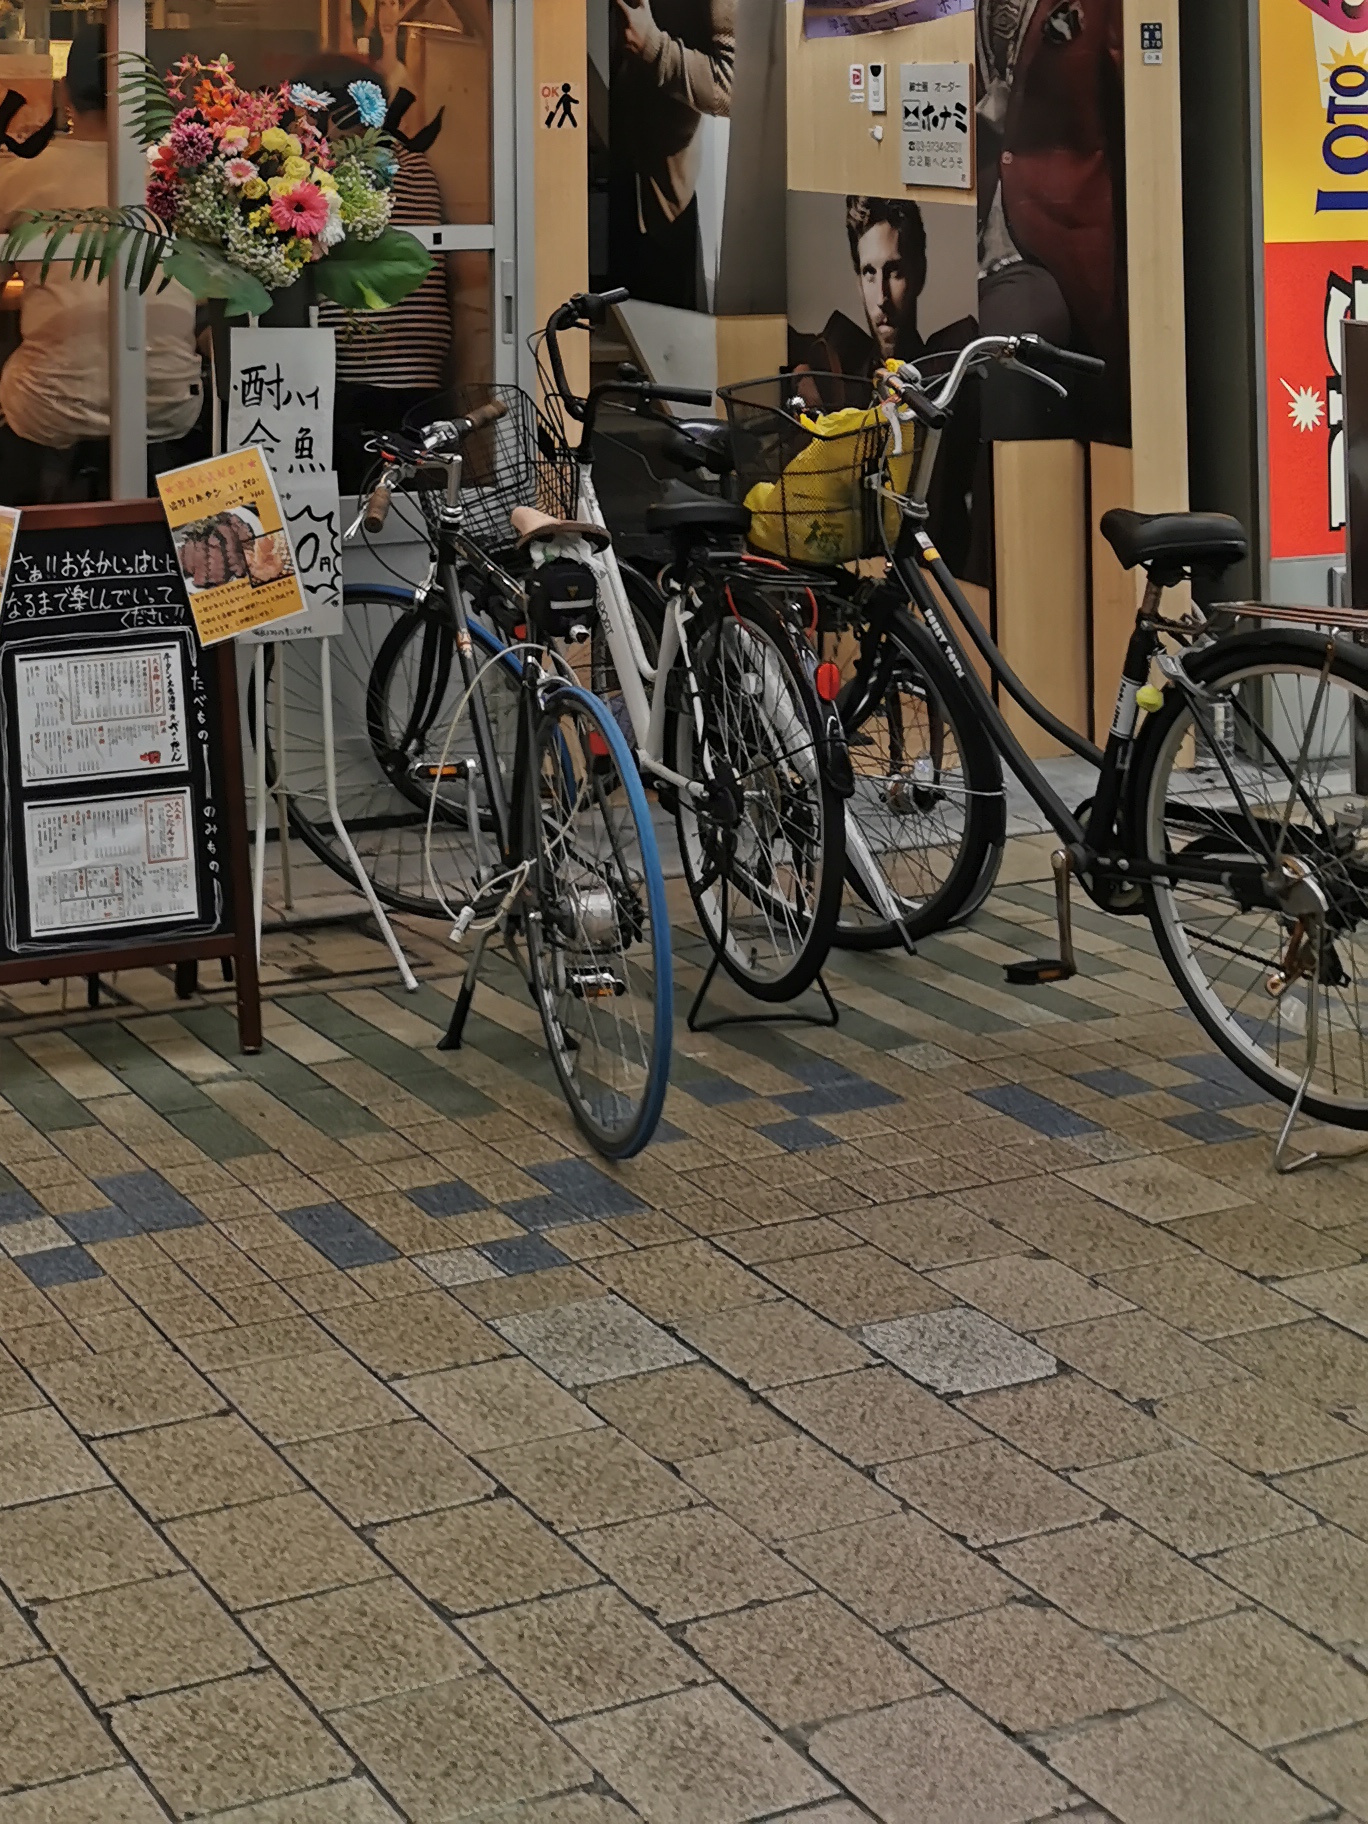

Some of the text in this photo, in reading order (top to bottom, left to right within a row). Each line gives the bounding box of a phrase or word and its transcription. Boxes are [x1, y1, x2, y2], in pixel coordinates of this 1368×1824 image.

[541, 86, 560, 99] OK
[922, 101, 968, 134] ホナミ
[5, 585, 173, 619] なるまで楽しんでいって
[191, 671, 209, 740] たべもの
[203, 806, 219, 873] のみもの
